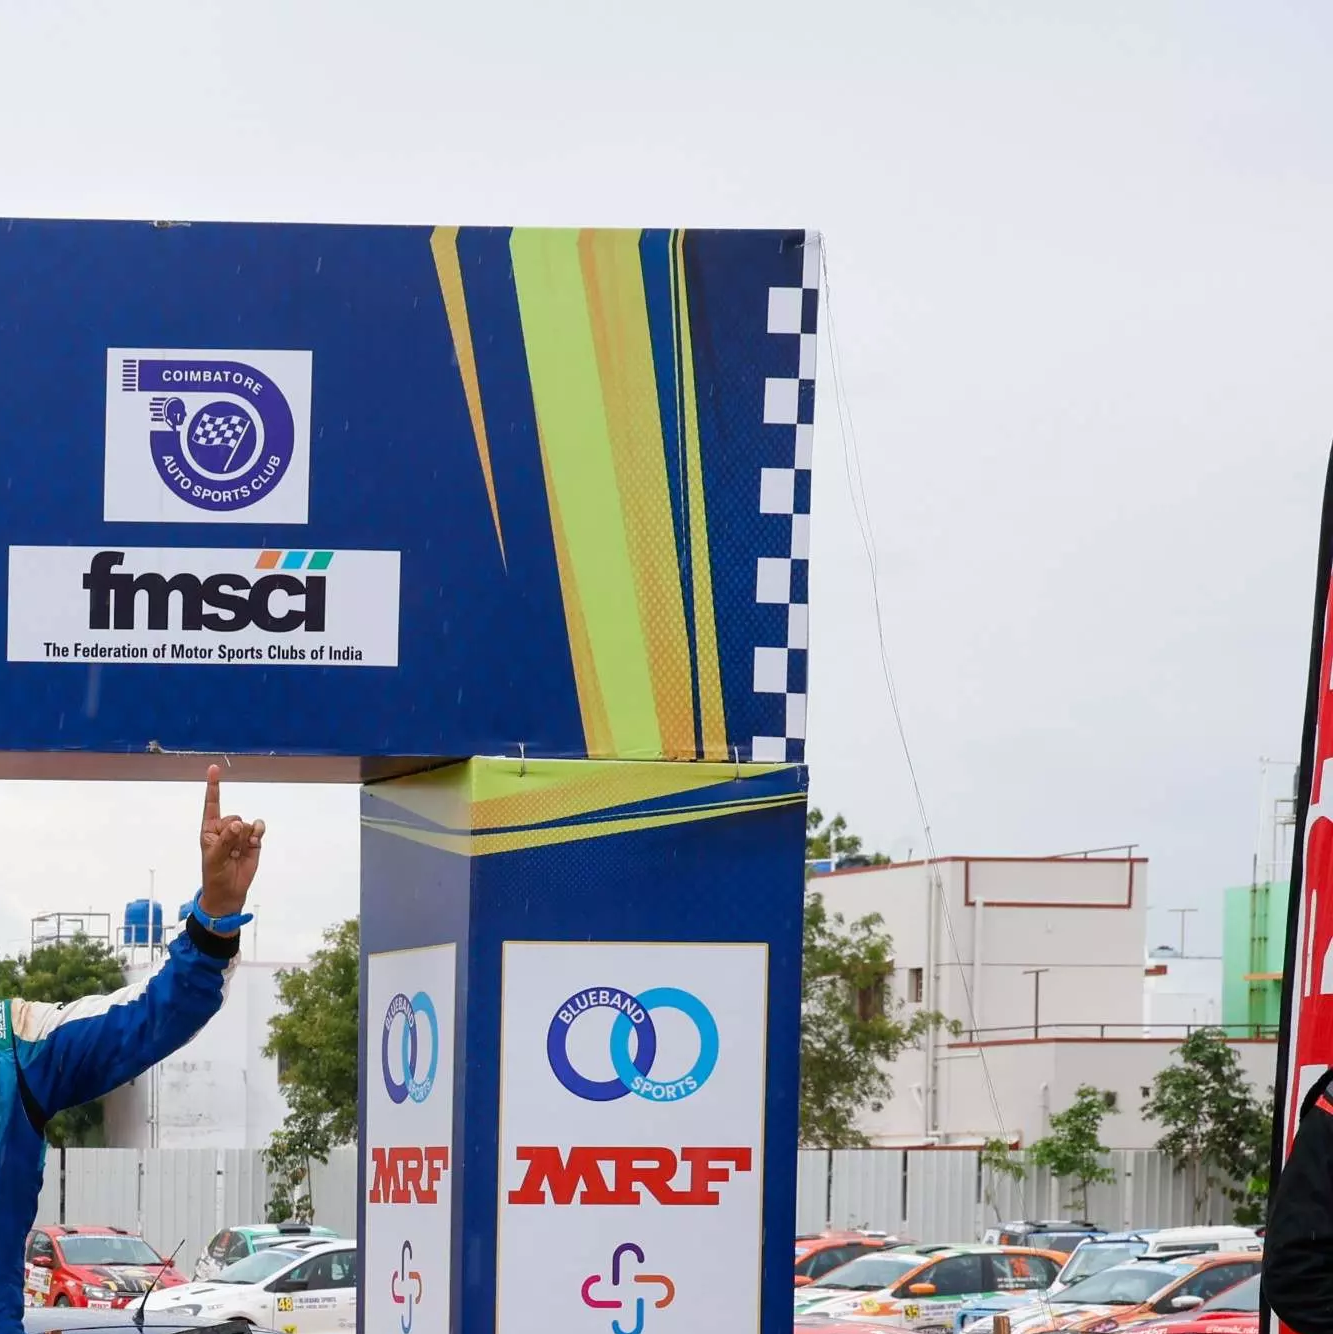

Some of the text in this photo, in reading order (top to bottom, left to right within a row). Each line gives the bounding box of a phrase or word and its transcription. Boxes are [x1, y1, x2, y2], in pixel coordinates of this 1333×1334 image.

[161, 369, 263, 396] COIMBATORE
[160, 454, 281, 503] AUTO SPORTS CLUB
[82, 551, 327, 632] fmsci
[44, 643, 363, 662] The Federation of Motor Sports Clubs of India
[558, 990, 645, 1026] BLUEBAND
[631, 1076, 698, 1100] SPORTS
[369, 1145, 448, 1204] MRF
[508, 1146, 752, 1205] MRF
